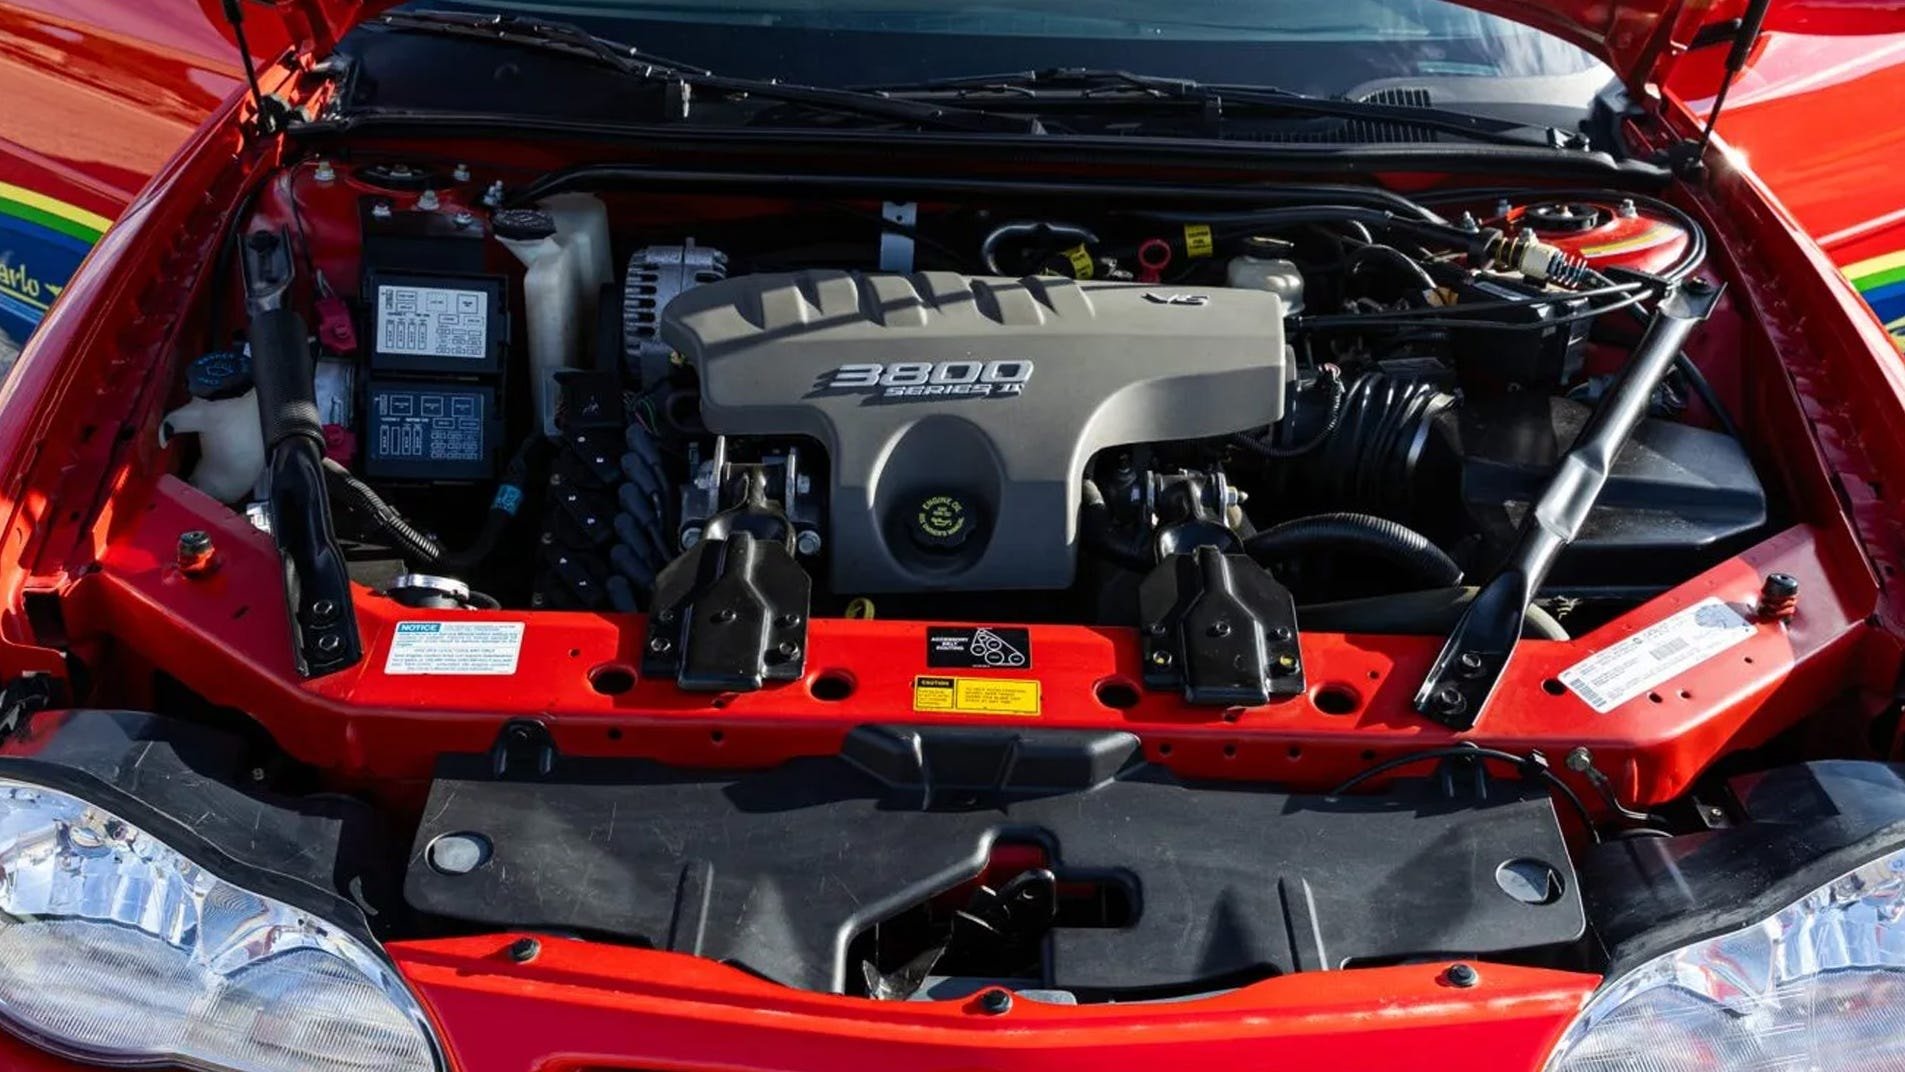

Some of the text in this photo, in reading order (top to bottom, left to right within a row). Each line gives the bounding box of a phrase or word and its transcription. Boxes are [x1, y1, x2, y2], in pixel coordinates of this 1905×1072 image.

[830, 360, 1034, 387] 3800
[884, 384, 992, 397] SERIES
[922, 497, 952, 510] ENGINE
[401, 624, 438, 632] NOTICE
